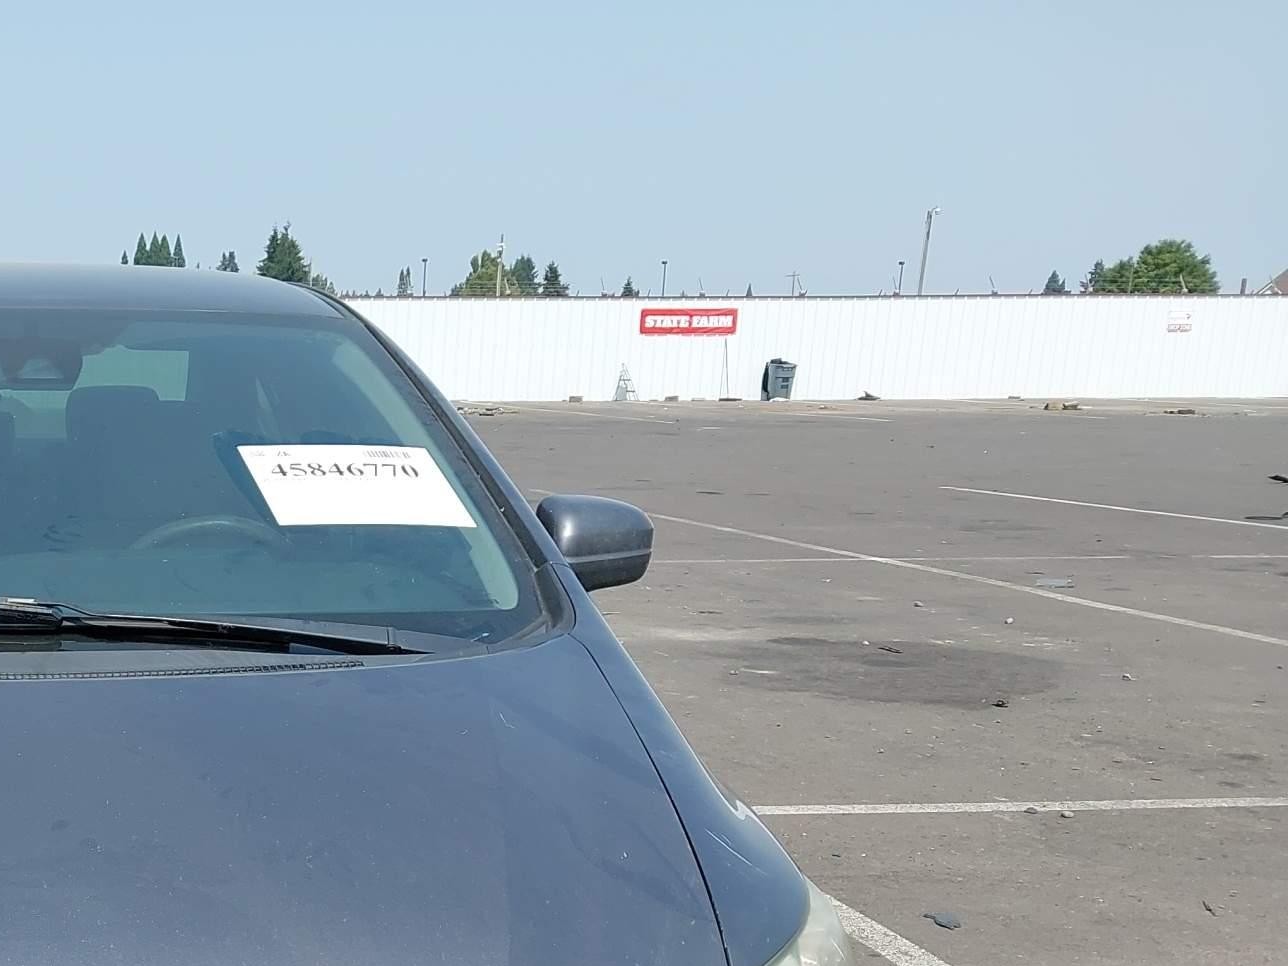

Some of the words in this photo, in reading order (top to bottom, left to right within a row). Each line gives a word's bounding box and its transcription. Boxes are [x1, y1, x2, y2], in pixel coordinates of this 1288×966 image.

[645, 315, 689, 328] STATE
[691, 315, 733, 328] FARM
[272, 462, 419, 478] 45846770
